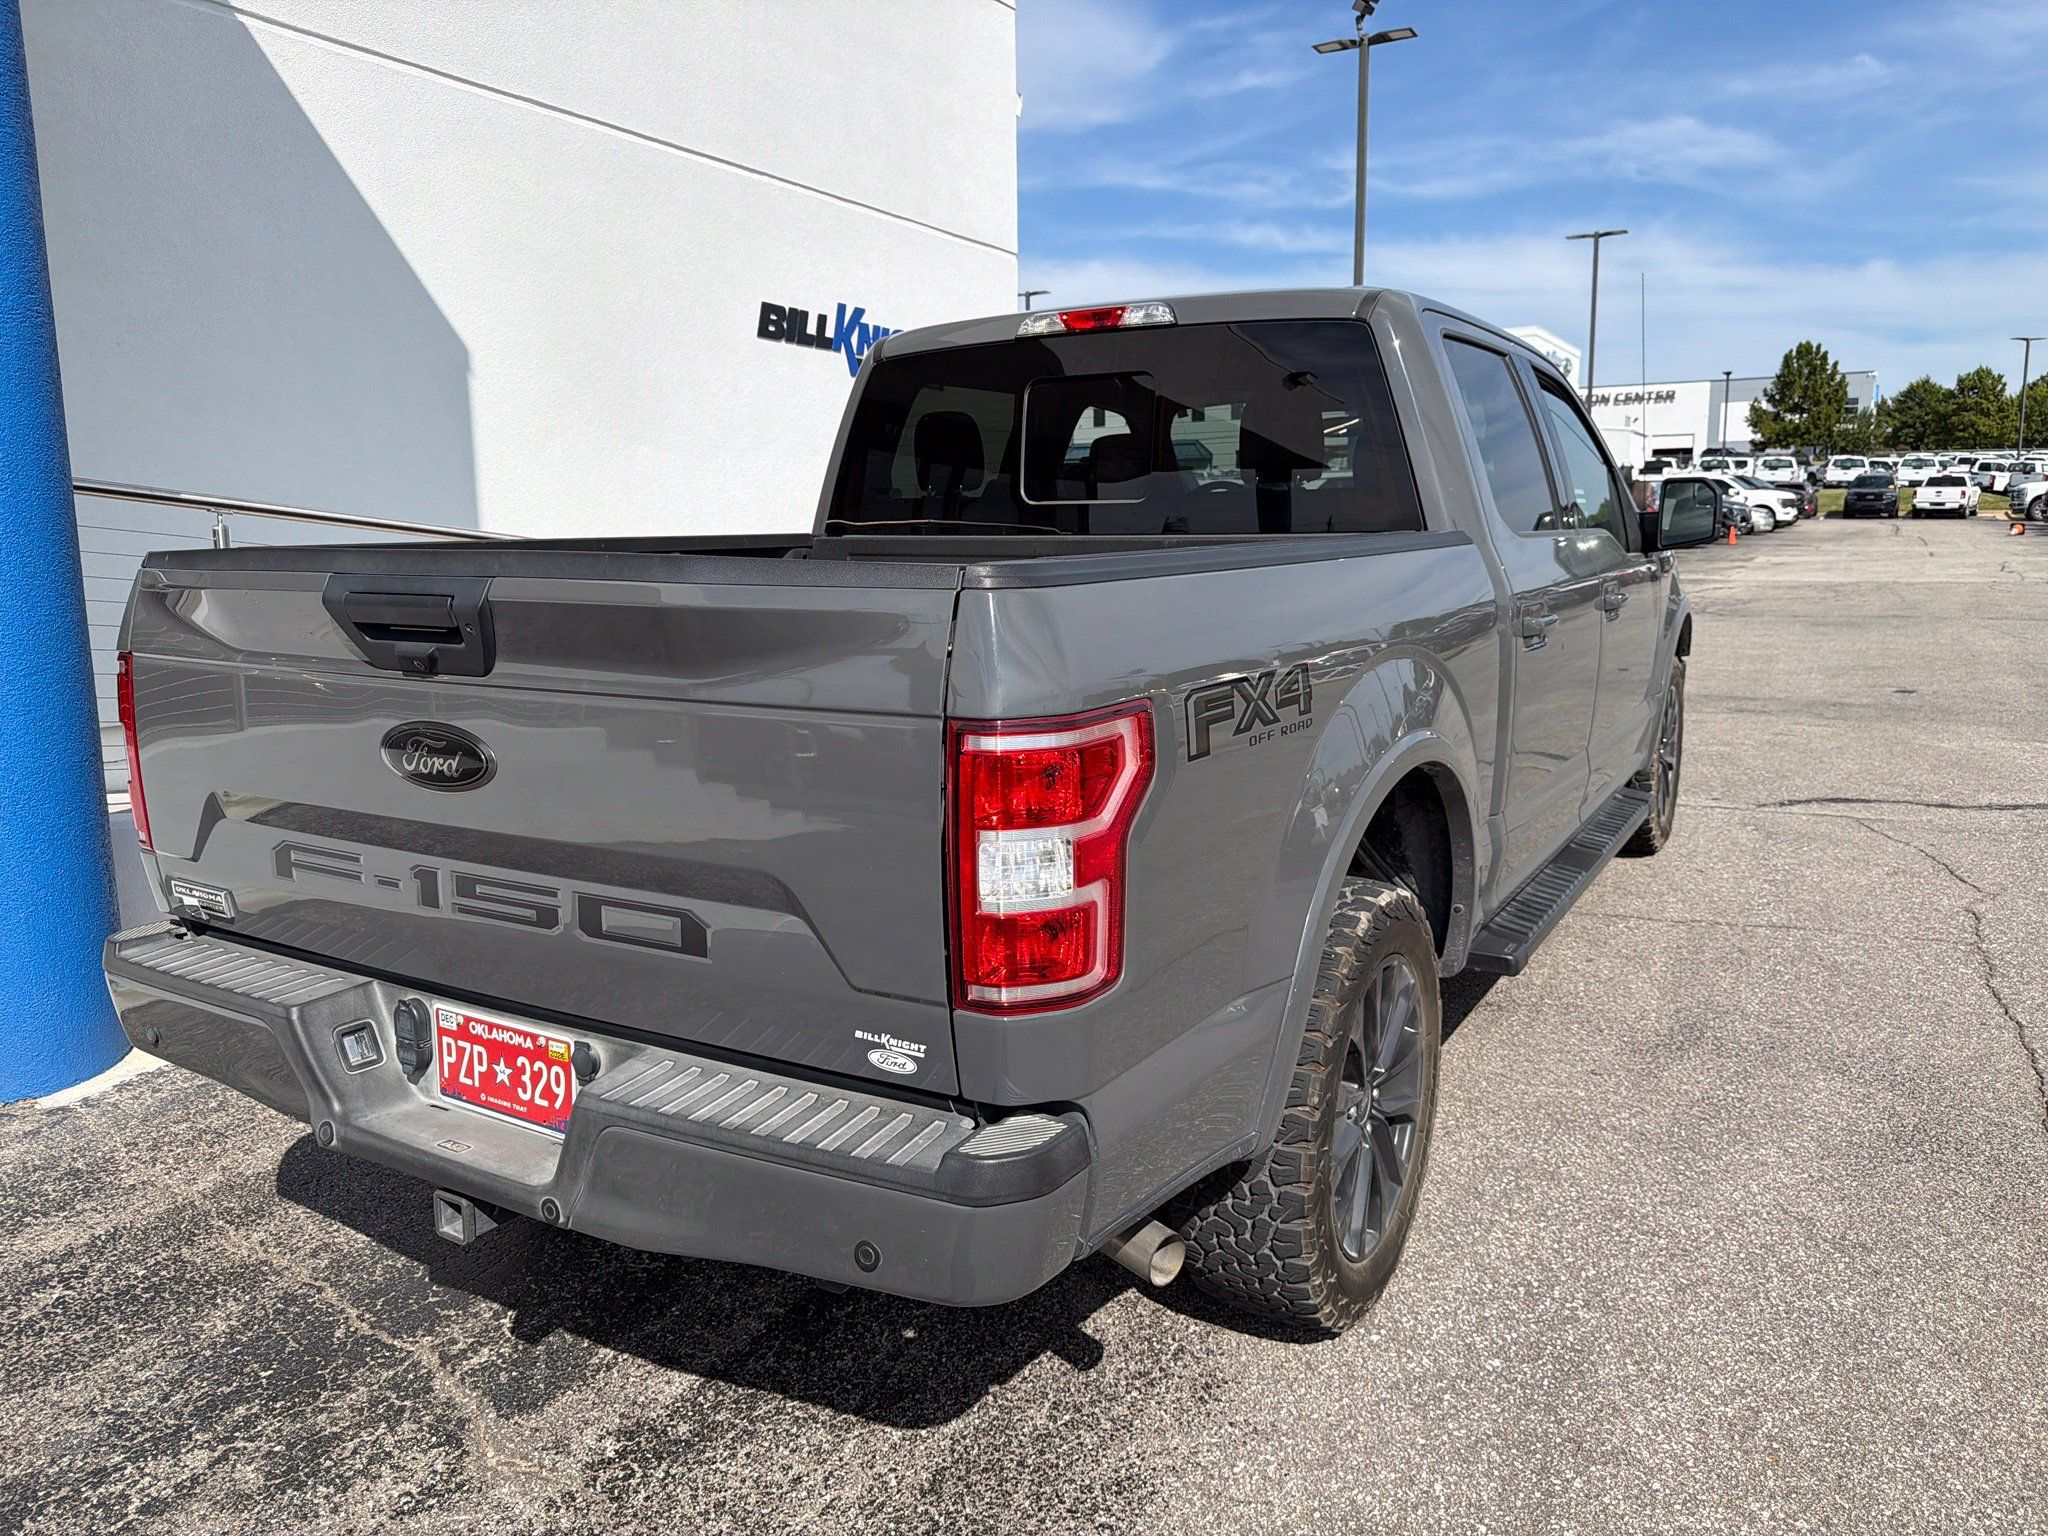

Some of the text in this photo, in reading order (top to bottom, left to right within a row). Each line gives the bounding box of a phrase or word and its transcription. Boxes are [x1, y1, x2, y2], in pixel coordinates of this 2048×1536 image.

[1613, 390, 1676, 406] CENTER
[1184, 662, 1313, 763] FX4
[1249, 717, 1313, 747] OFF ROAD
[402, 736, 463, 779] Ford
[175, 885, 223, 902] OKLAHOMA
[272, 840, 712, 964] F-150
[440, 1012, 454, 1024] DEC
[468, 1021, 534, 1050] OKLAHOMA
[441, 1035, 566, 1110] PZP 329
[877, 1052, 908, 1071] Ford
[487, 1095, 528, 1113] IMAGINE THAT
